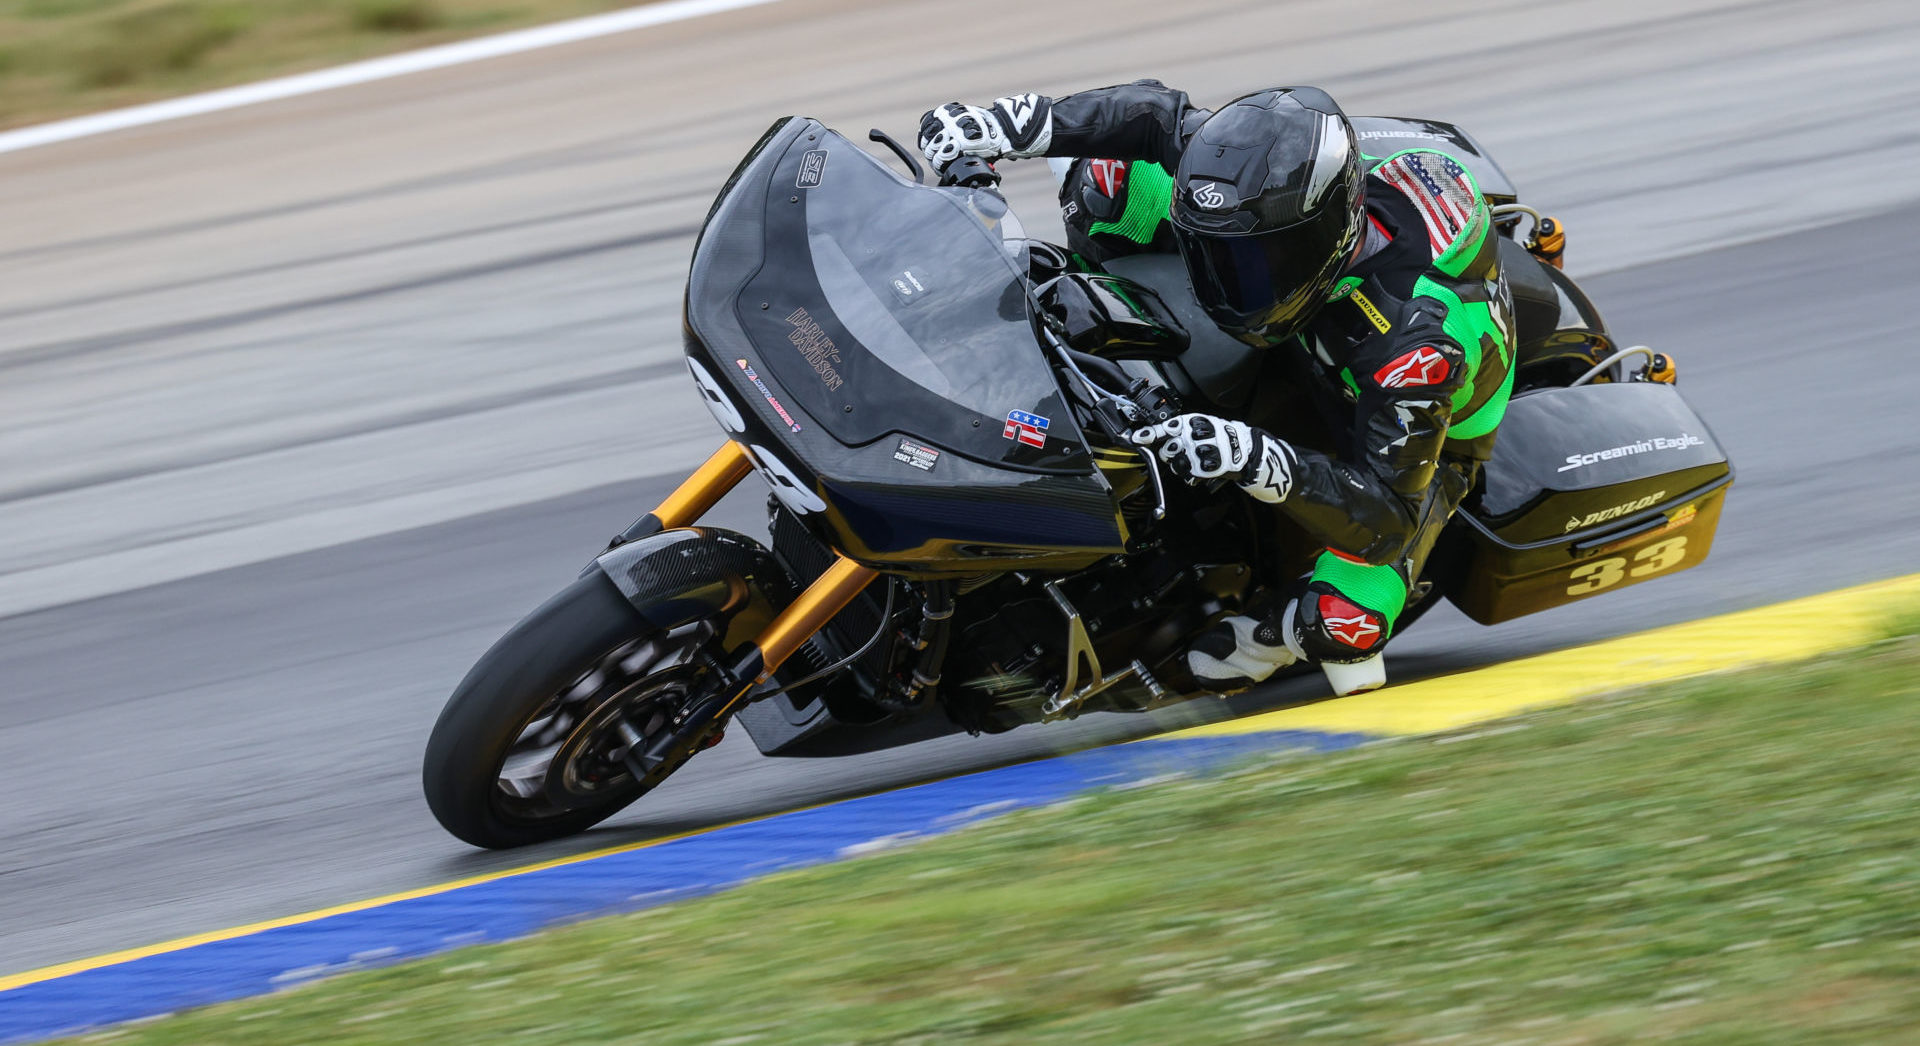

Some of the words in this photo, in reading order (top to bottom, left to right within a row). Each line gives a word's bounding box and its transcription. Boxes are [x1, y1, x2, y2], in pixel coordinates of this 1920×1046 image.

[1359, 297, 1388, 329] DUNLOP
[785, 306, 841, 363] HARLEY-
[788, 327, 843, 391] DAVIDSON
[894, 452, 910, 463] 2021
[1653, 433, 1704, 450] Eagle
[1580, 490, 1666, 527] DUNLOP
[1566, 536, 1688, 596] 33
